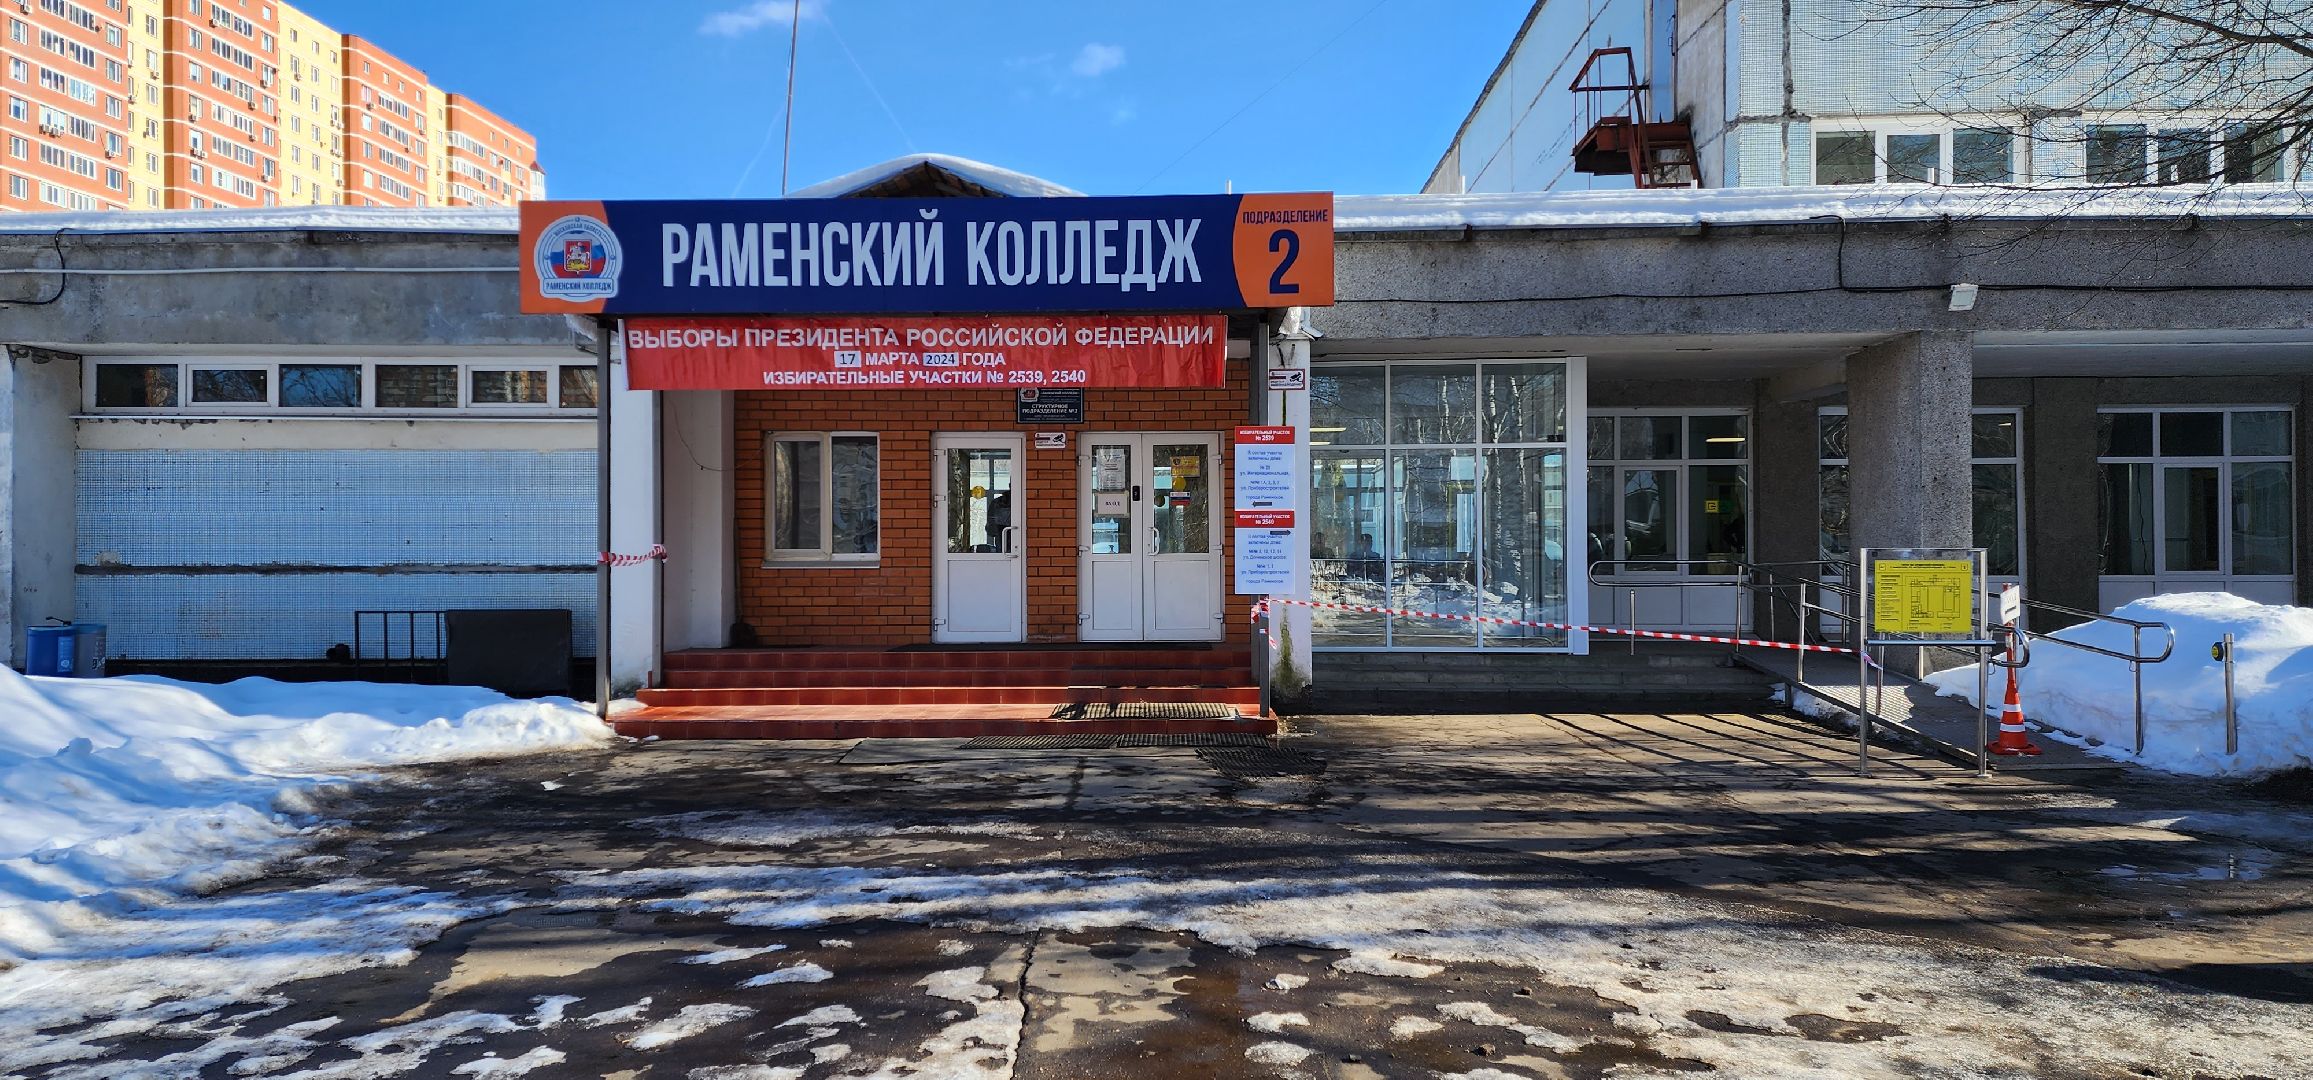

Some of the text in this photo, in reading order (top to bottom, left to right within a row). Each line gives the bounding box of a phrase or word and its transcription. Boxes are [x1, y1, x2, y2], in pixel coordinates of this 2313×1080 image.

[1242, 209, 1329, 225] ПОДРАЗДЕЛЕНИЕ
[662, 208, 1202, 292] РАМЕНСКИЙ КОЛЛЕДЖ
[1268, 228, 1300, 295] 2
[545, 281, 612, 291] РАМЕНСКИЙ КОЛЛЕДЖ
[627, 322, 1214, 351] ВЫБОРЫ ПРЕЗИДЕНТА РОССИЙСКОЙ ФЕДЕРАЦИИ
[838, 352, 1007, 368] 17 МАРТА 2024 ГОДА
[763, 370, 1087, 386] ИЗБИРАТЕЛЬНЫЕ УЧАСТКИ № 2539, 2540
